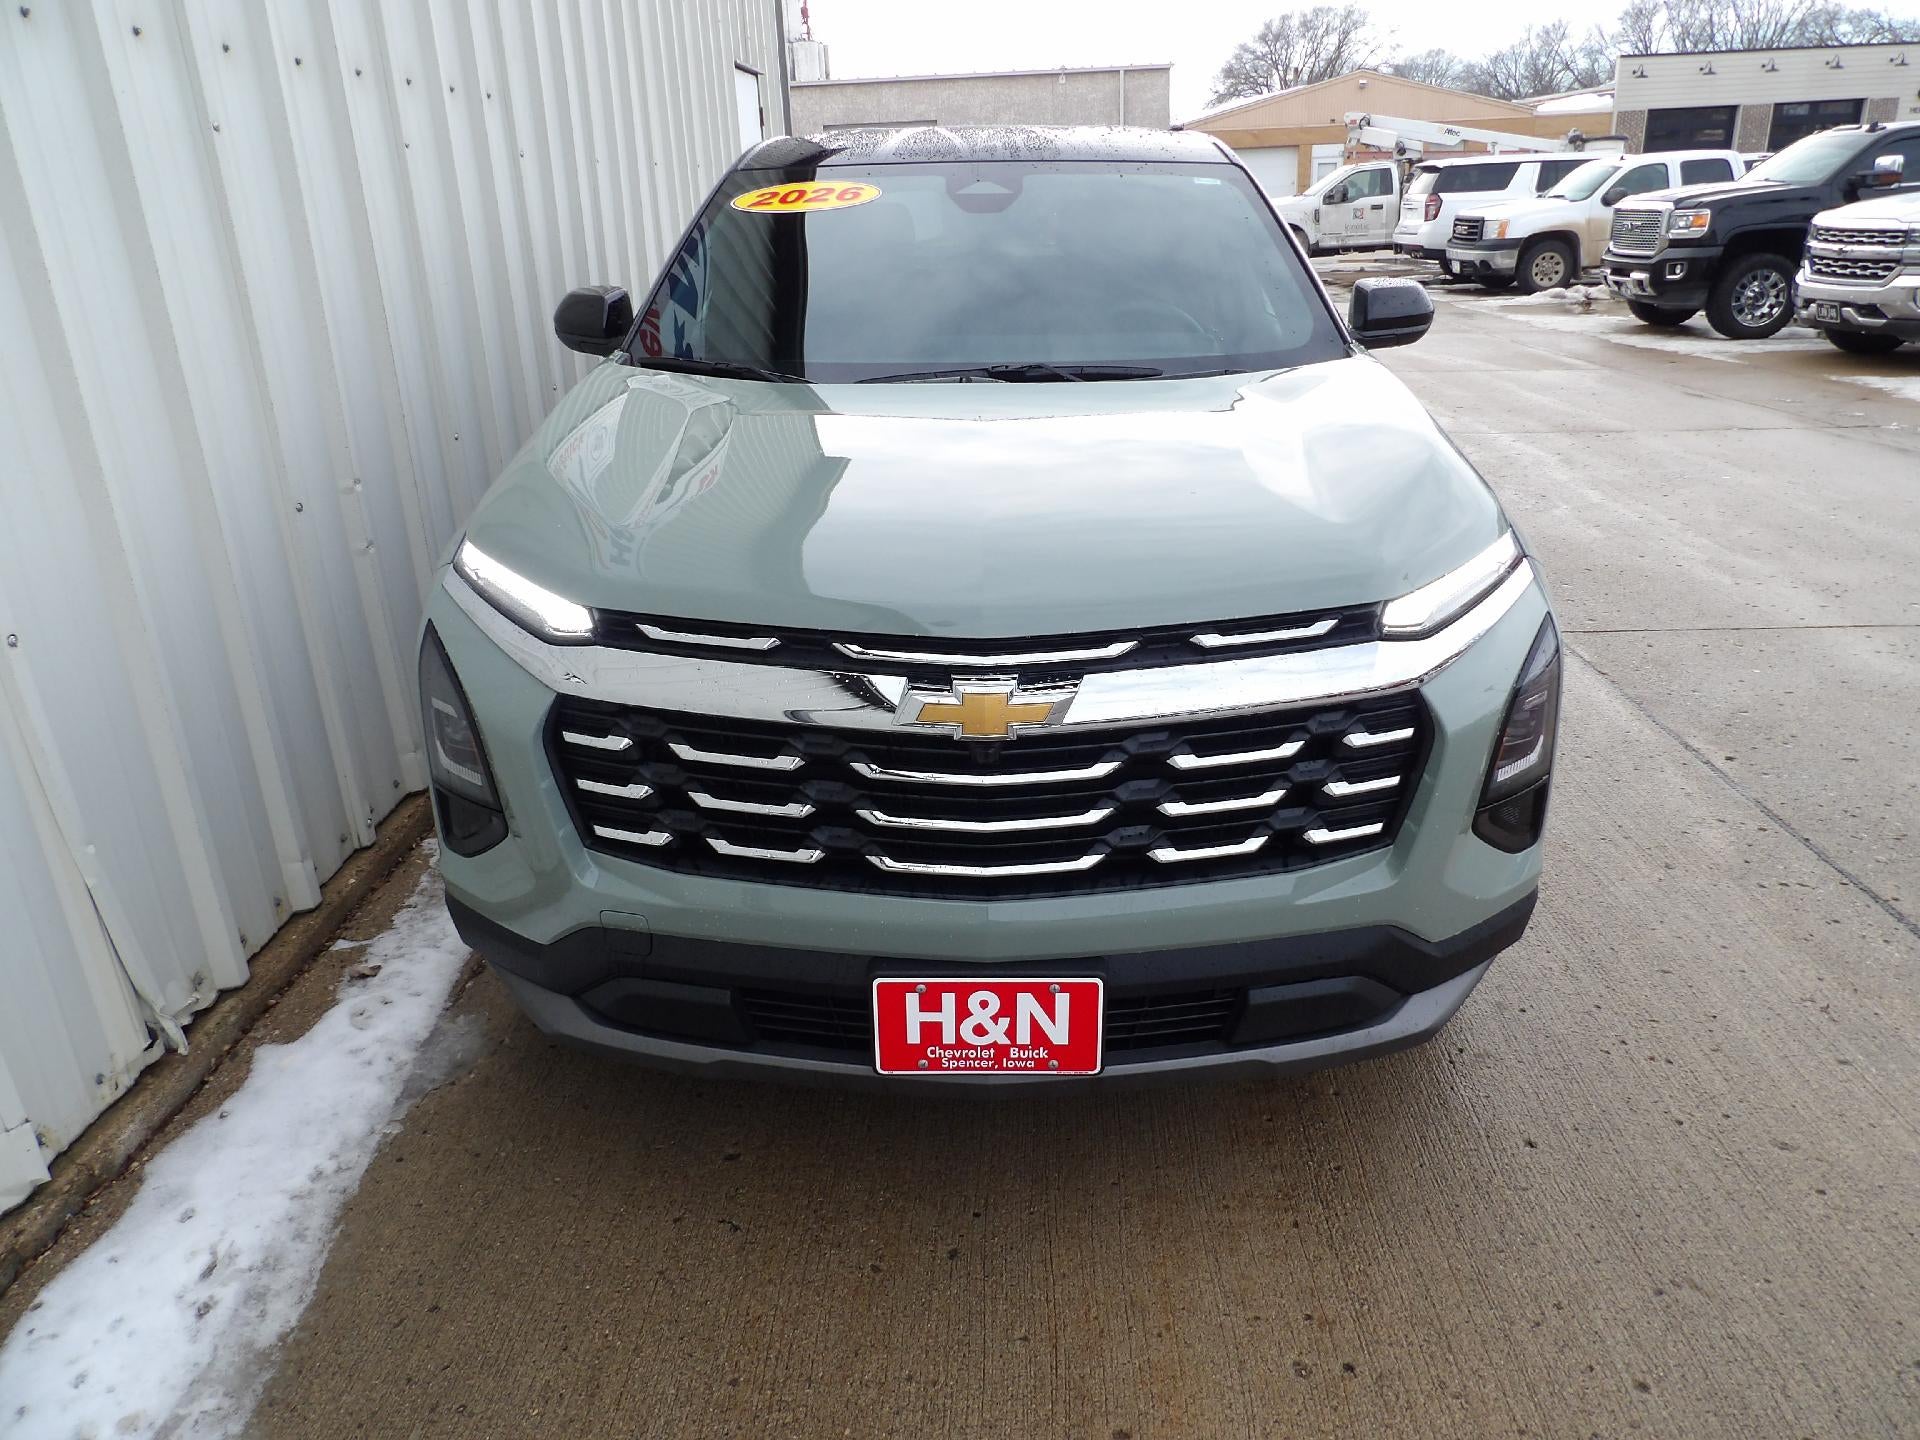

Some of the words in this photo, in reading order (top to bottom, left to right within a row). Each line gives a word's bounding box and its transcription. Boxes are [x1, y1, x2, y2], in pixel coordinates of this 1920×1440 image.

[746, 186, 865, 208] 2026
[905, 990, 1070, 1046] H&N
[926, 1046, 995, 1059] Chevrolet
[1009, 1046, 1049, 1059] Buick
[941, 1058, 998, 1069] Spencer,
[1003, 1058, 1035, 1068] Iowa
